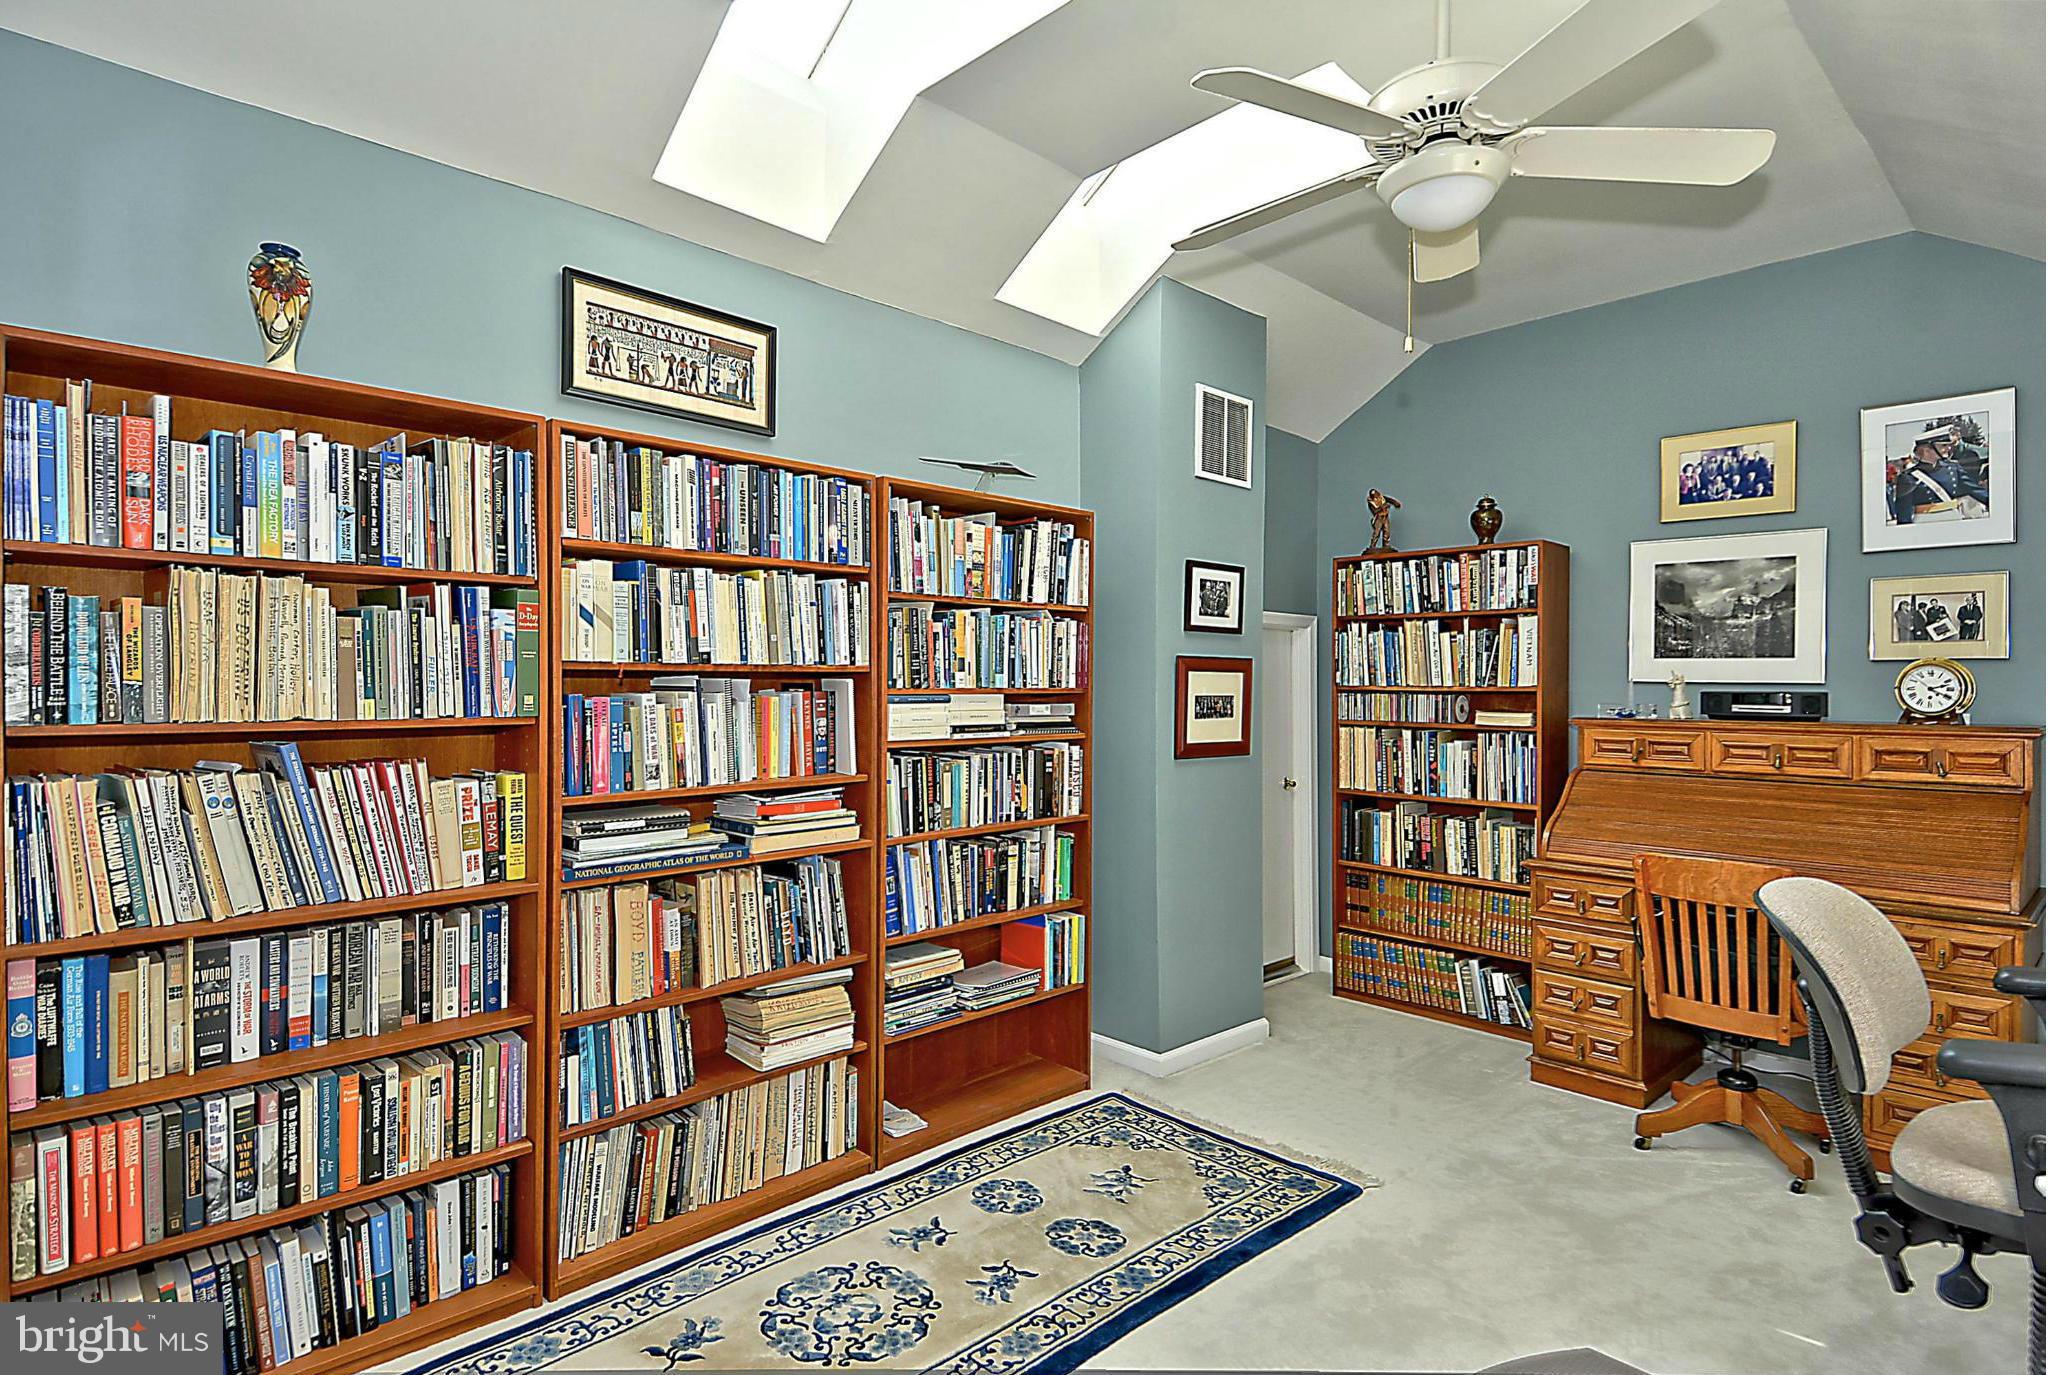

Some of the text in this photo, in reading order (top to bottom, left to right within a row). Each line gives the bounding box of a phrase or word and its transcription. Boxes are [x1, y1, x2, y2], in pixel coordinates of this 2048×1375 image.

[95, 418, 117, 455] RICHARD RHODES
[126, 417, 151, 472] RICHARD RHODES
[95, 472, 104, 507] ATOMIC
[107, 460, 117, 529] THE MAKING OF
[244, 454, 256, 500] Crystal Fire
[342, 447, 351, 506] SKUNK WORKS
[371, 483, 379, 507] Rocket
[567, 442, 576, 528] HAYEK'S CHALLENGE
[582, 461, 590, 494] CONSTITUTION
[125, 498, 151, 525] DARK SUN
[175, 502, 186, 525] EMPIRES
[268, 459, 279, 544] THE IDEA FACTORY
[392, 480, 402, 554] AMERICAN RAIDERS
[495, 479, 505, 536] Airborne Radar
[739, 489, 748, 525] UNSEEN
[841, 503, 849, 526] AGAINST
[852, 499, 860, 541] SILENT VICTORY
[95, 509, 104, 535] BOMB
[371, 527, 380, 547] Reich
[31, 628, 42, 685] CODEBREAKERS
[49, 592, 65, 695] BEHIND THE BATTLE
[126, 634, 133, 643] OF
[1525, 628, 1534, 667] VIETNAM
[105, 628, 118, 704] THE PUZZLE PALACE
[155, 613, 165, 717] OPERATION OVERFLIGHT
[428, 656, 437, 694] FULLER
[648, 704, 659, 716] SIX
[649, 717, 660, 734] DAYS
[650, 745, 661, 760] WAR
[1072, 759, 1081, 798] FIASCO
[461, 786, 476, 822] PRIZE
[510, 795, 524, 845] THE QUEST
[485, 803, 500, 849] LEMAY
[101, 815, 131, 907] COMMAND IN WAR
[121, 832, 145, 908] SUPPLYING WAR
[575, 851, 734, 878] NATIONAL GEOGRAPHIC ATLAS OF THE WORLD
[630, 900, 645, 943] BOYD
[780, 910, 792, 945] BOYD
[194, 970, 200, 984] A
[200, 966, 230, 983] WORLD
[269, 940, 281, 1011] MASTERS AND COMMANDERS
[347, 932, 363, 985] KOREAN WAR
[205, 990, 230, 1008] ARMS
[37, 991, 58, 1047] The LUFTWAFFE WAR DIARIES
[119, 994, 129, 1075] THE NARROW MARGIN
[370, 1084, 383, 1128] Lost Victories
[457, 1073, 470, 1106] GENIUS
[456, 1125, 468, 1145] WAR
[457, 1106, 468, 1125] FOR
[83, 1136, 93, 1176] MILITARY
[106, 1132, 116, 1170] MILITARY
[129, 1127, 139, 1166] MILITARY
[286, 1105, 298, 1176] The Breaking Point
[319, 1158, 327, 1178] Keegan
[672, 1155, 681, 1181] PENTAGON
[590, 1164, 602, 1233] WARFARE MODELING
[628, 1187, 637, 1213] LEADERS
[641, 1162, 653, 1217] THE WAR GAME
[670, 1182, 679, 1197] WARS
[221, 1282, 237, 1330] LONG VIEW
